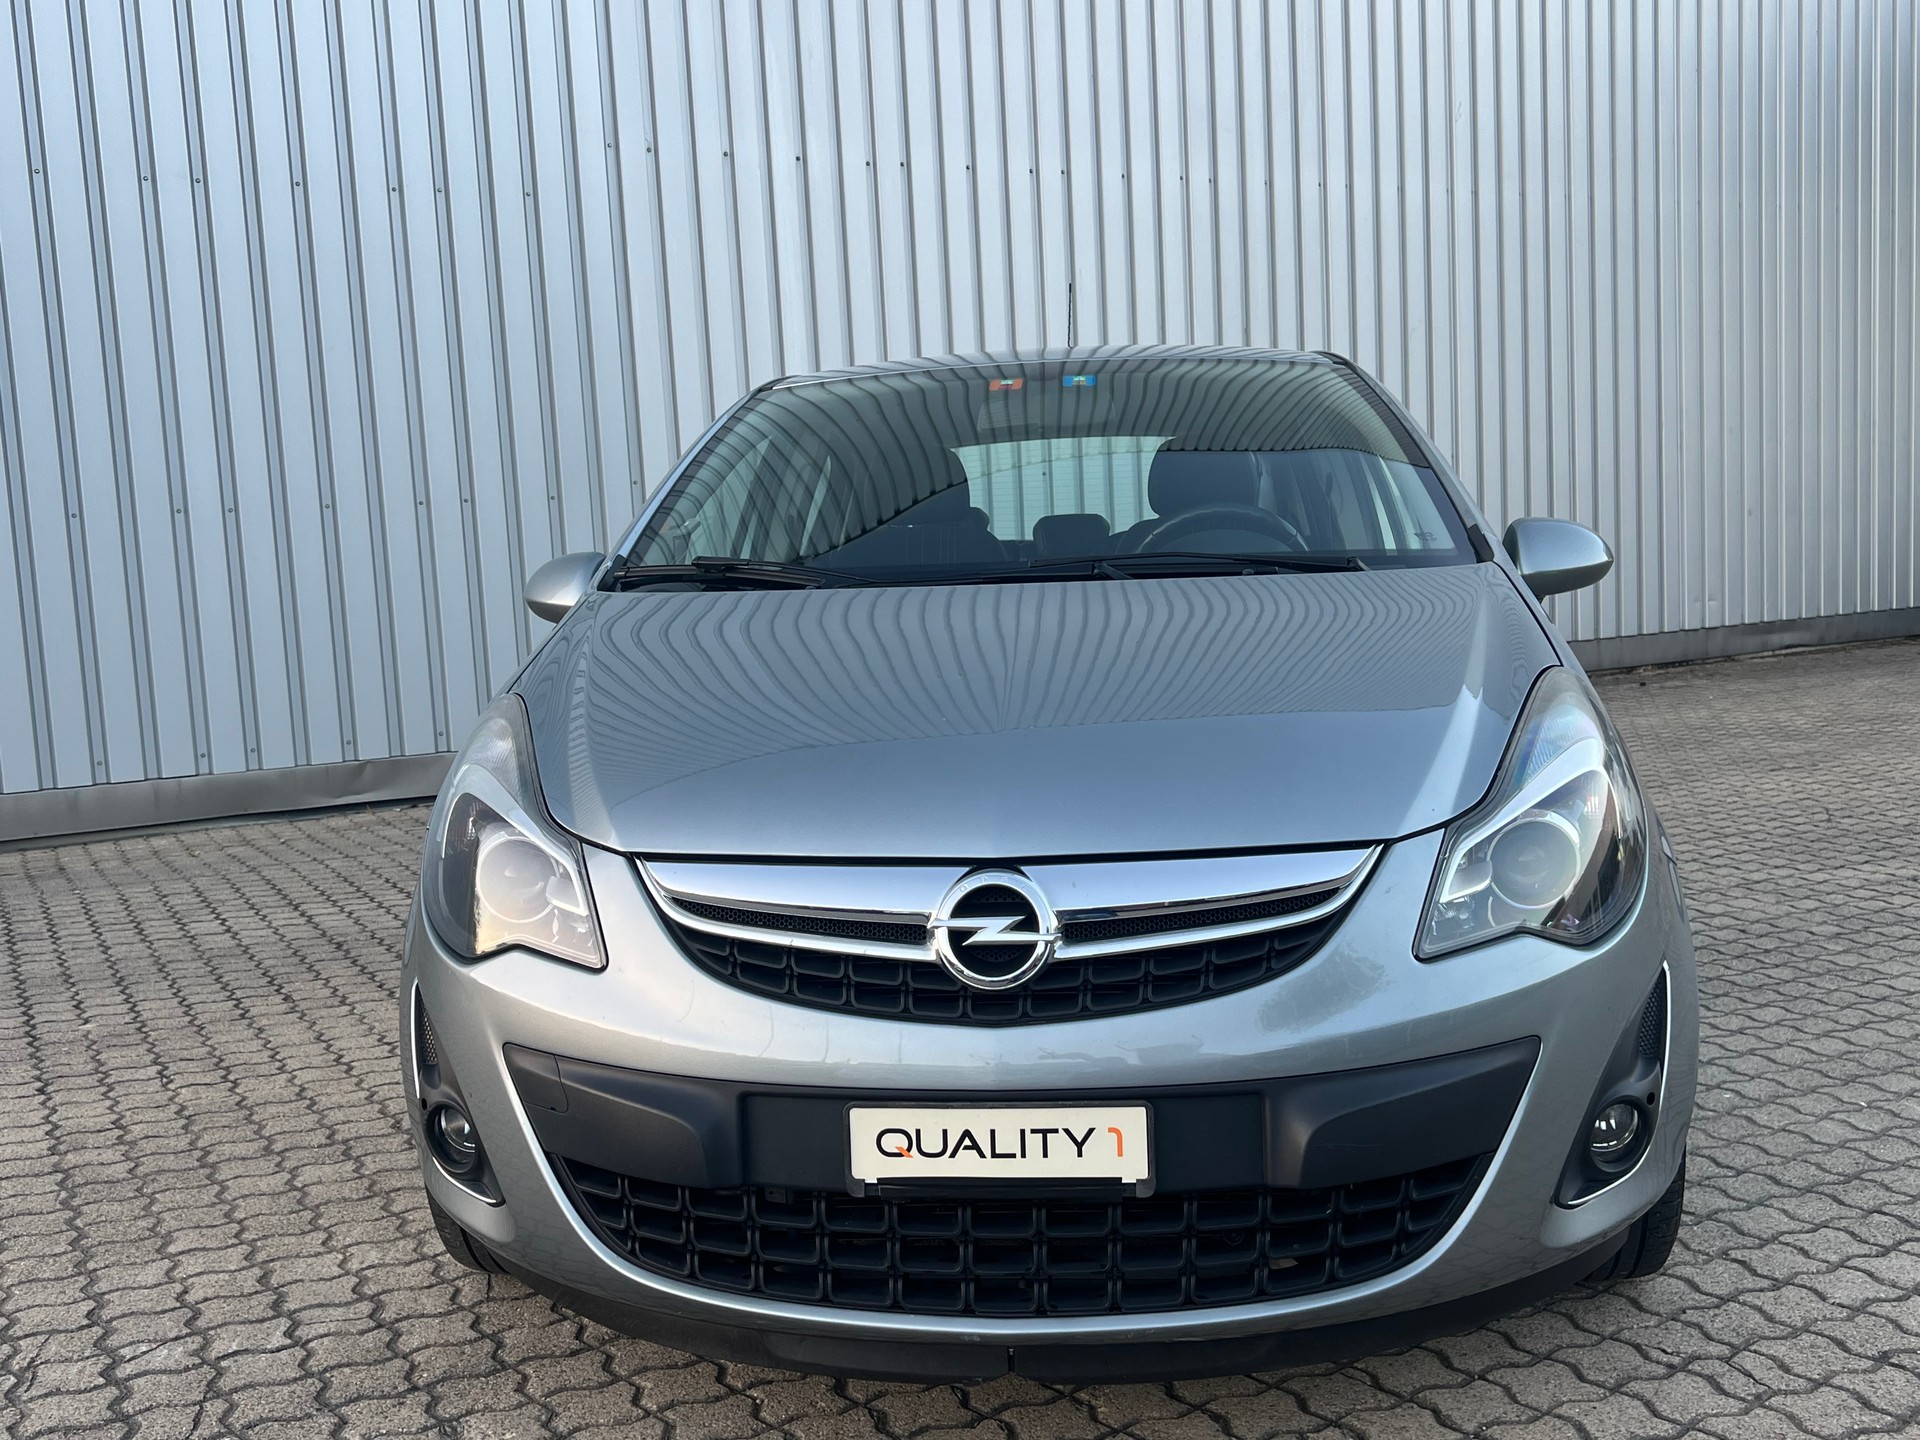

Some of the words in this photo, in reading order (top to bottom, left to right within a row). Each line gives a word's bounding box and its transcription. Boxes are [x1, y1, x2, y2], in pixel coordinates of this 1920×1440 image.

[959, 875, 1026, 892] OPEL
[875, 1127, 1097, 1159] QUALITY
[1107, 1126, 1124, 1158] 1
